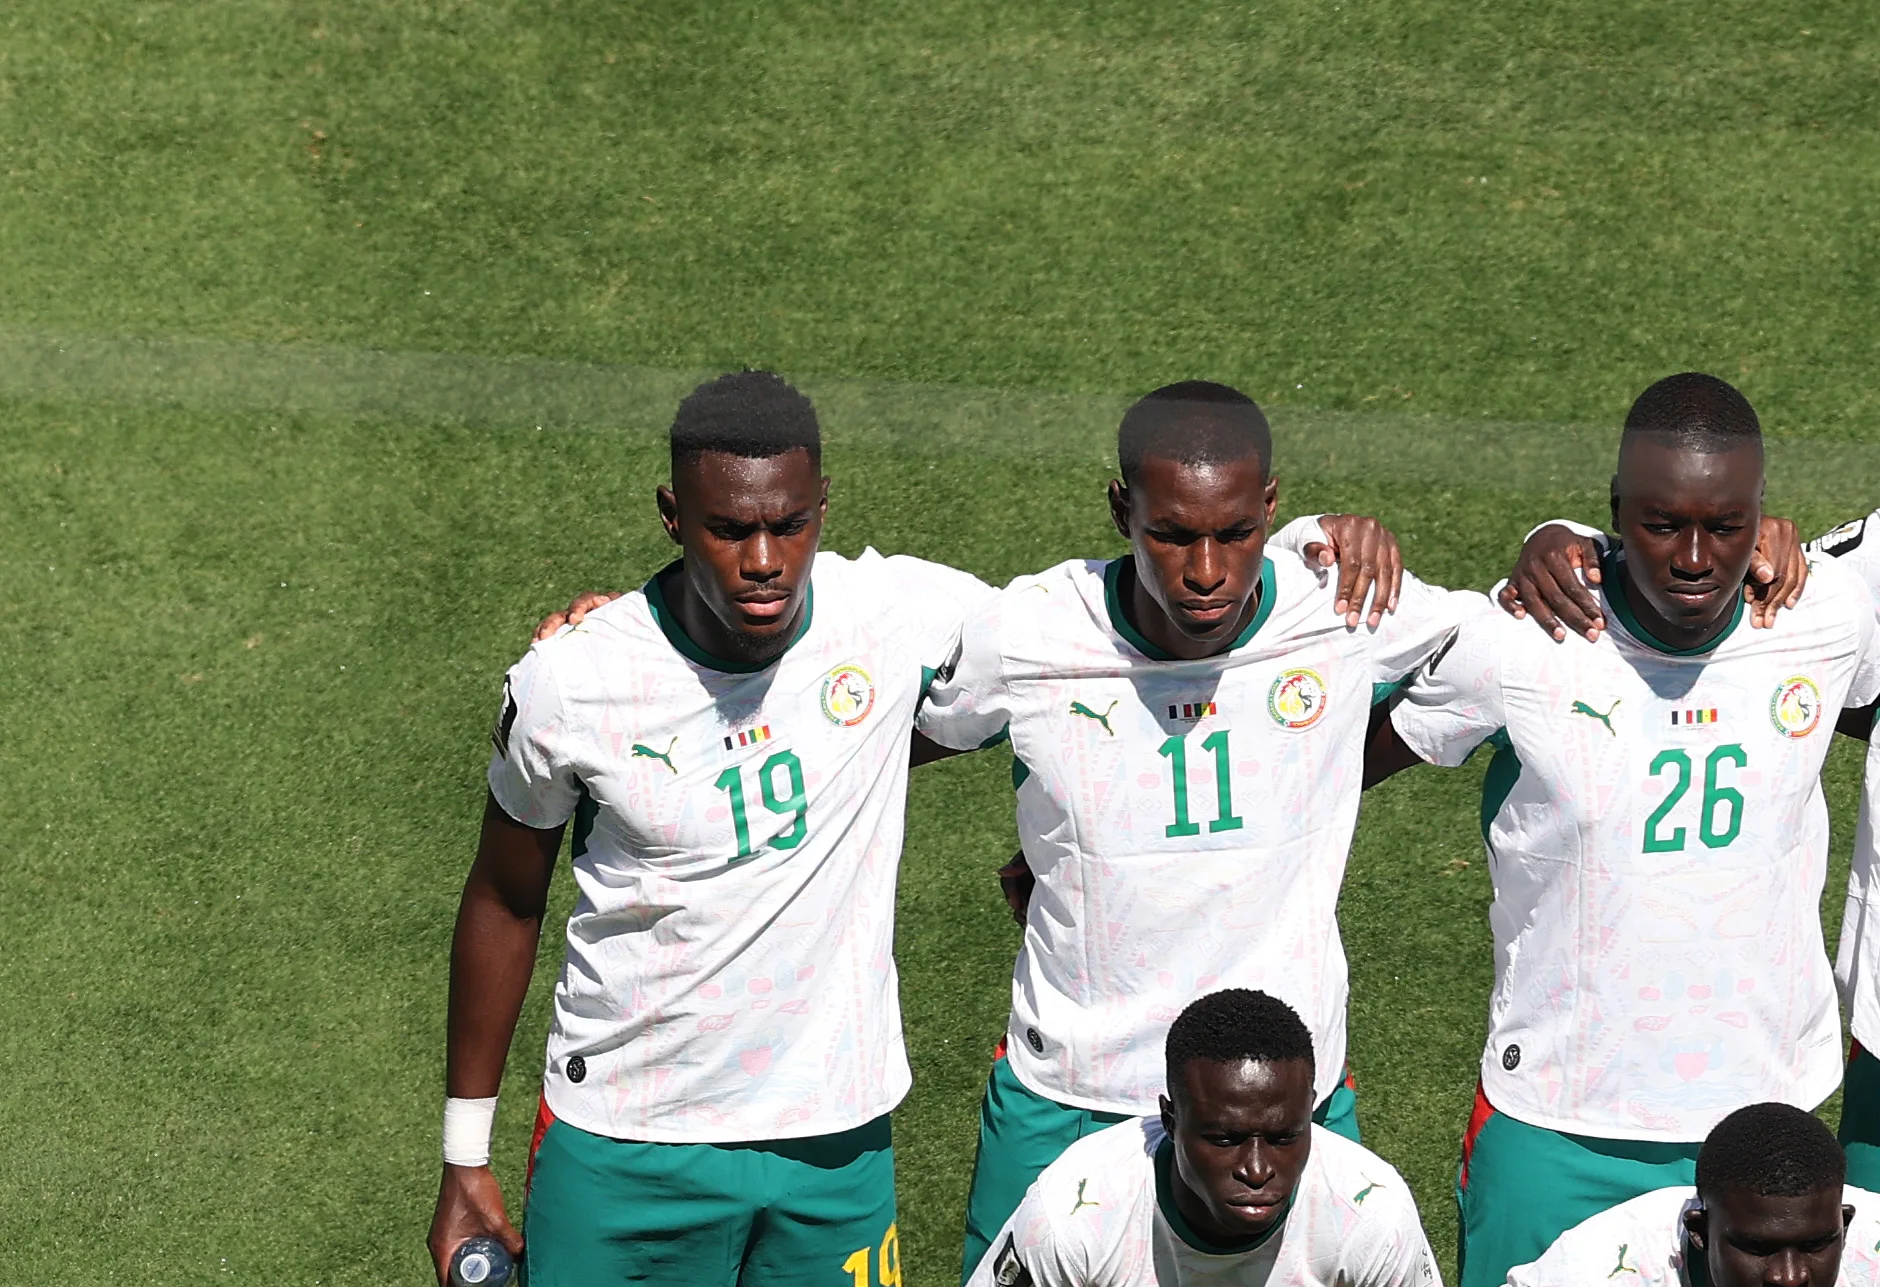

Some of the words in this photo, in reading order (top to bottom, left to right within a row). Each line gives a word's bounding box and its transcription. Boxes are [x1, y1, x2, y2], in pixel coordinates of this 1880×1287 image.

[714, 748, 808, 864] 19
[1157, 729, 1244, 837] 11
[1642, 742, 1747, 853] 26
